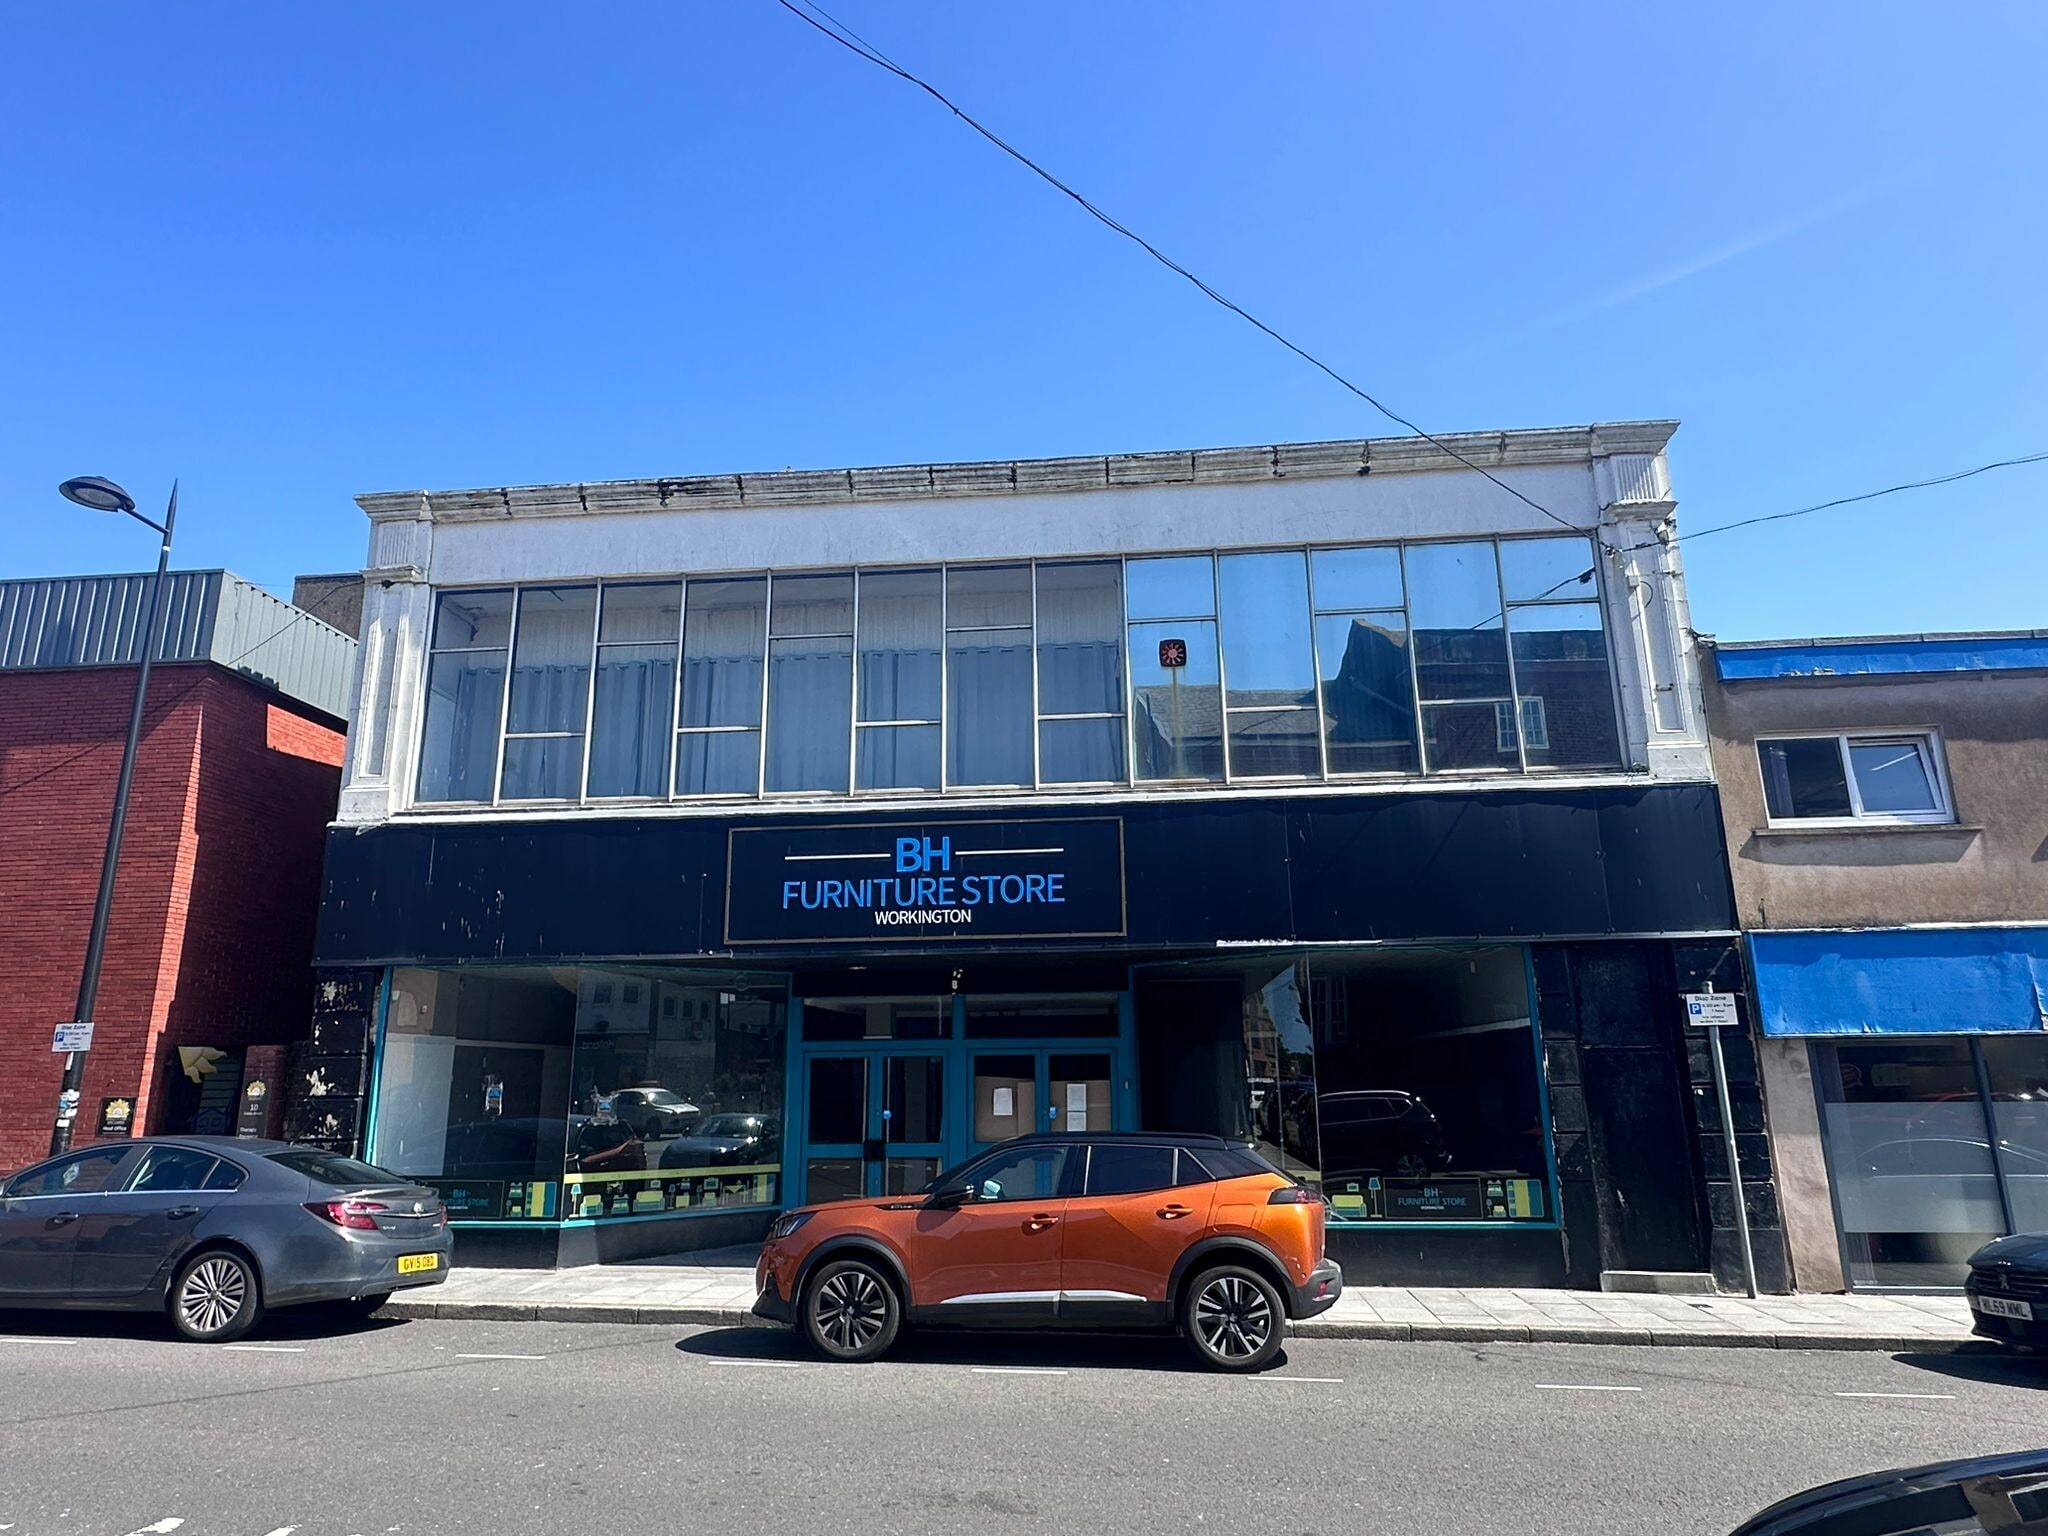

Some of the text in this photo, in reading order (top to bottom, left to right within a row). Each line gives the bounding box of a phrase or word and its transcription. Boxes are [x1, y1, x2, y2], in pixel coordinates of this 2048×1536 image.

[895, 836, 950, 873] BH
[782, 874, 1065, 910] FURNITURE STORE
[874, 909, 972, 926] WORKINGTON
[1692, 1004, 1700, 1014] P
[249, 1103, 259, 1111] 10
[453, 1188, 466, 1198] BH
[1423, 1187, 1439, 1197] BH
[1397, 1197, 1467, 1206] FURNITURE STORE
